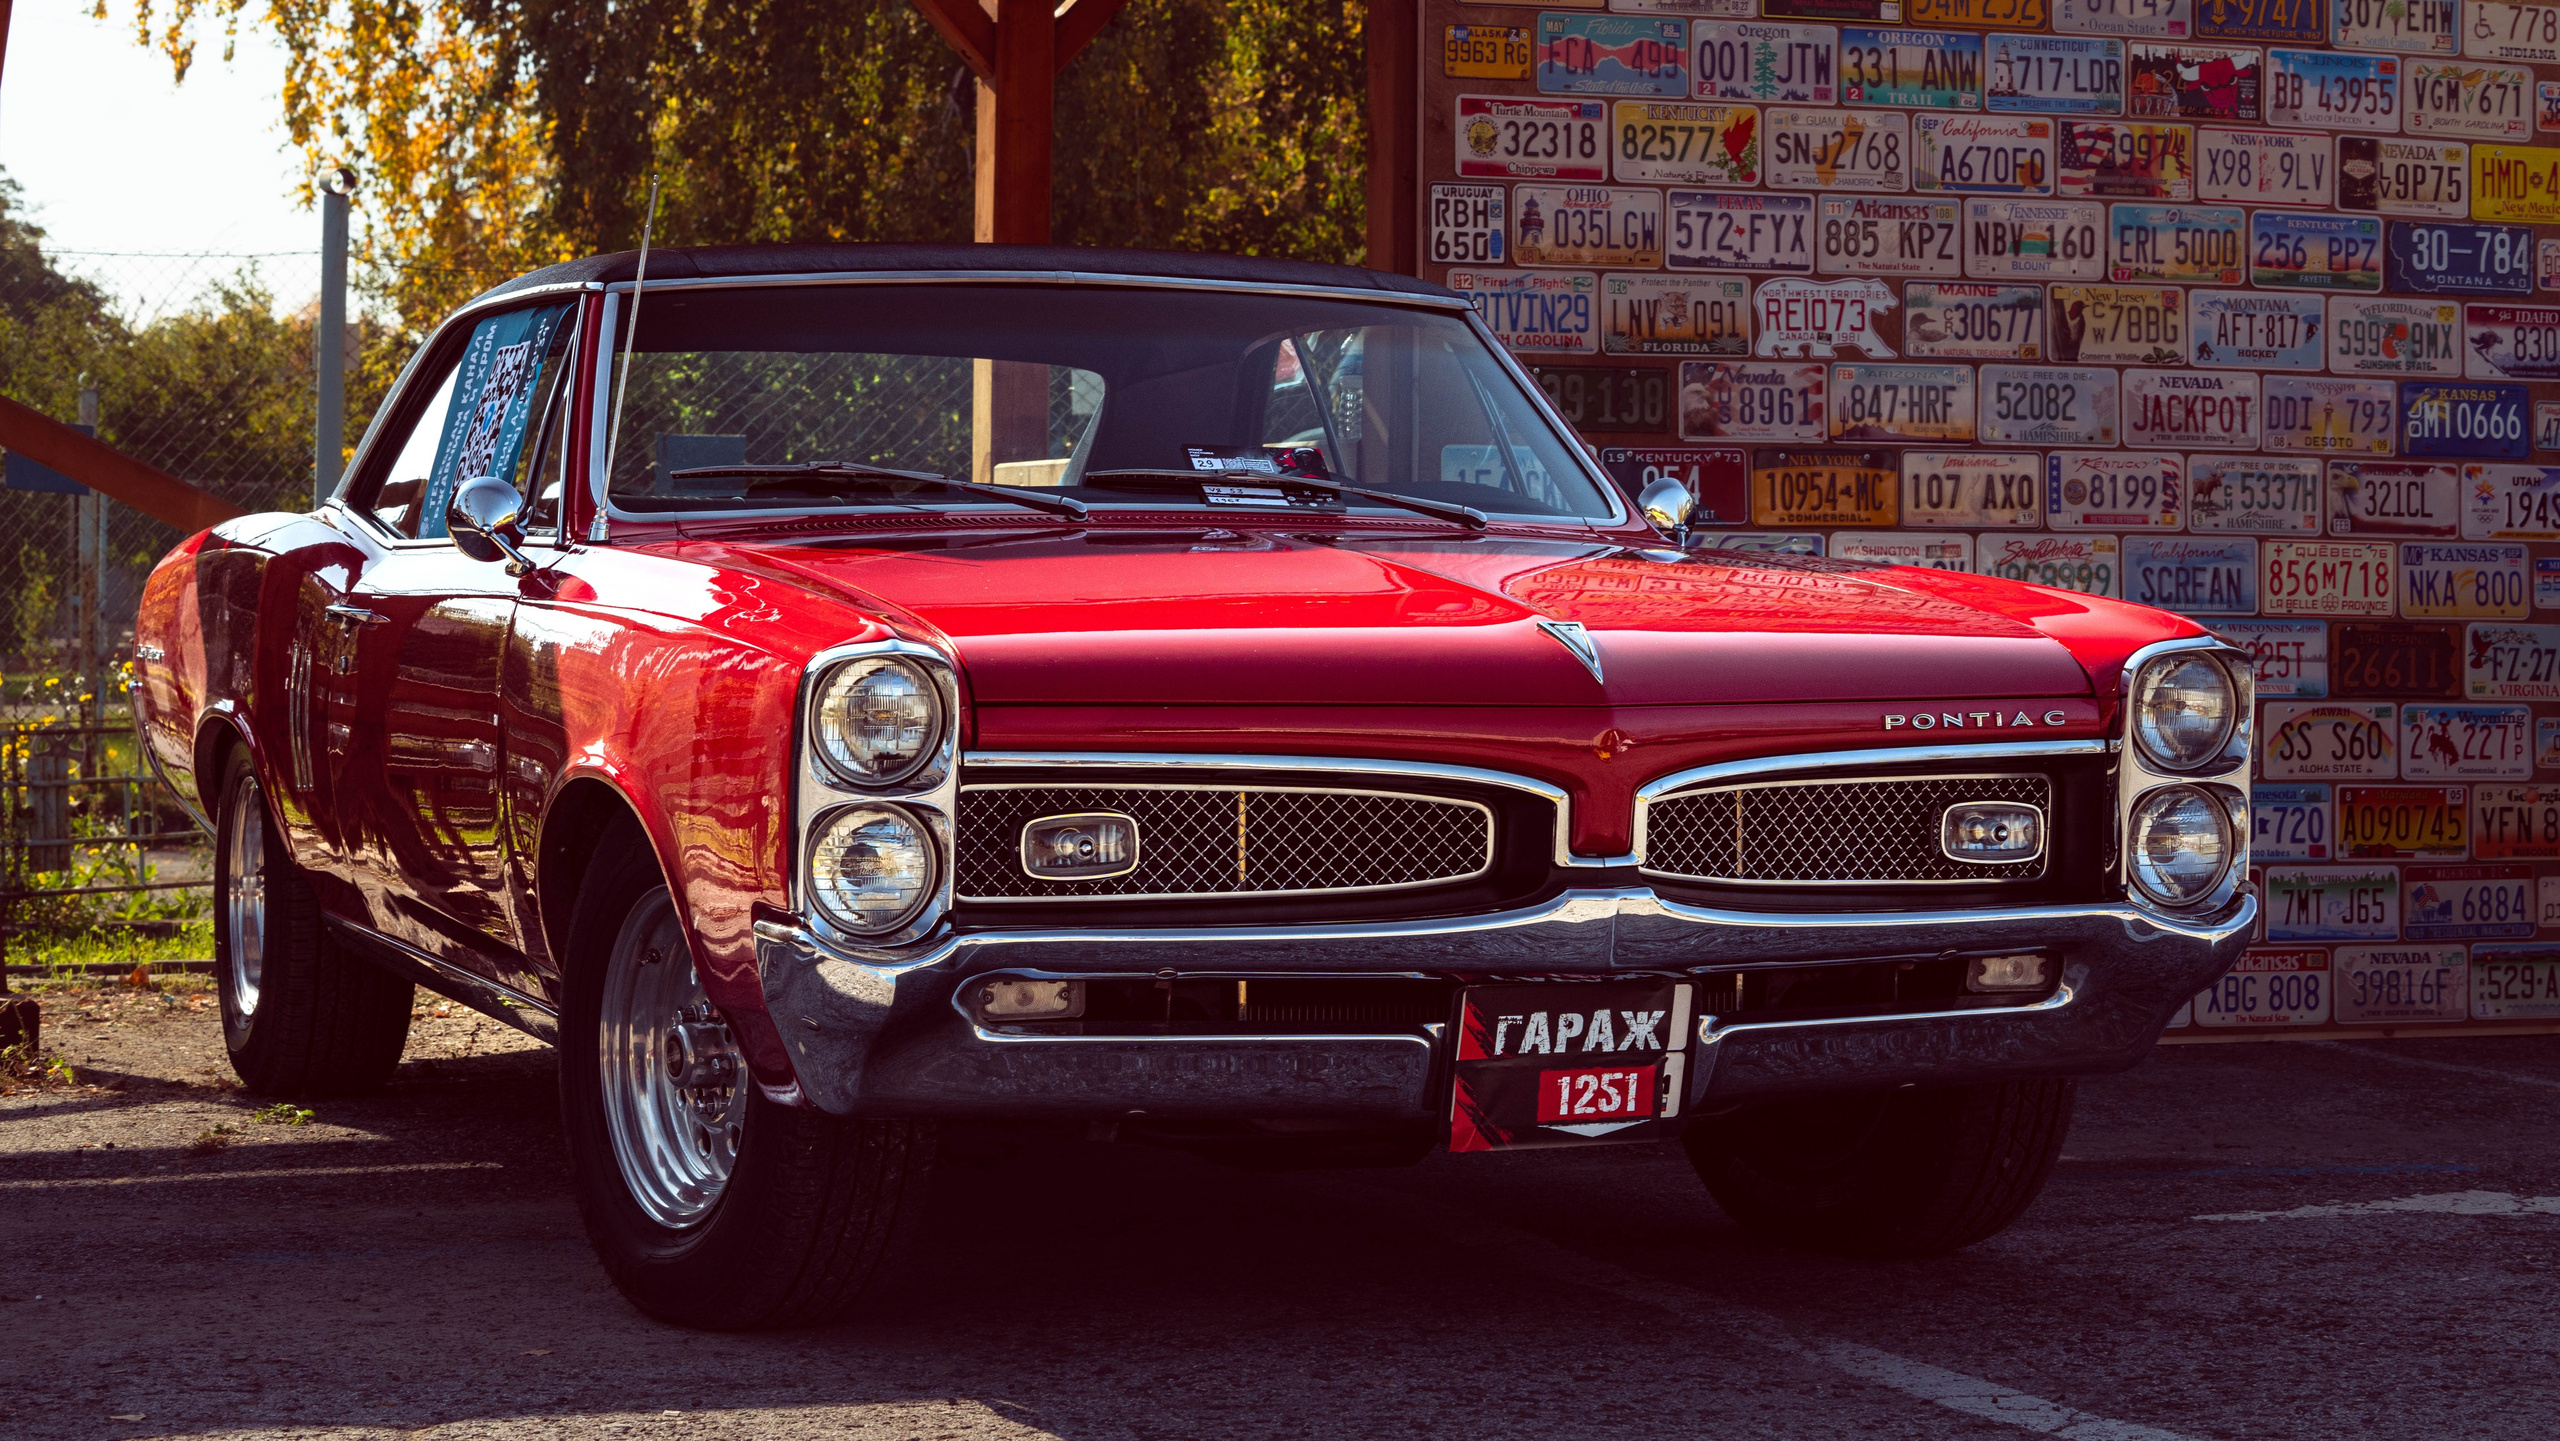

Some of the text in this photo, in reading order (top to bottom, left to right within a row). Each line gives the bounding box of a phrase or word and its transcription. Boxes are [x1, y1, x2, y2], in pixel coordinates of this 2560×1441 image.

[1546, 20, 1564, 33] MAY
[1584, 17, 1633, 36] Florida
[1737, 24, 1790, 42] Oregon
[2089, 18, 2156, 34] Ocean State
[1469, 29, 1508, 38] ALASKA
[1878, 31, 1945, 46] OREGON
[2020, 39, 2091, 52] CONNECTICUT
[2364, 35, 2426, 50] South Carolina
[1448, 42, 1528, 64] 9963 RG
[1548, 37, 1678, 78] FCA 499
[2499, 46, 2557, 60] INDIANA
[1699, 40, 1830, 85] 001 JTW
[1848, 46, 1976, 91] 331 ANW
[1887, 92, 1936, 106] TRAIL
[2274, 72, 2303, 110] BB
[2318, 75, 2393, 115] 43955
[2414, 78, 2520, 117] VGM 671
[1494, 104, 1569, 119] Turtle Mountain
[1648, 104, 1728, 122] KENTUCKY
[1806, 115, 1836, 127] GUAM
[1922, 119, 1939, 130] SEP
[2465, 121, 2505, 130] CAROLINA
[1942, 118, 2023, 139] California
[1504, 121, 1596, 159] 32318
[1622, 124, 1715, 162] 82577
[2231, 133, 2295, 148] NEW YORK
[1776, 131, 1900, 171] SNJ2768
[2377, 143, 2437, 161] NEVADA
[1508, 161, 1555, 176] Chippewa
[1696, 170, 1723, 181] Finest
[2207, 148, 2324, 190] X98 9LV
[1834, 178, 1874, 186] CHAMORRO
[1442, 187, 1493, 198] URUGUAY
[1566, 188, 1610, 203] OHIO
[1715, 195, 1763, 211] TEXAS
[1851, 199, 1930, 220] Arkansas
[2502, 201, 2524, 213] New
[1435, 199, 1488, 228] RBH
[1973, 205, 1988, 216] MAR
[1676, 210, 1805, 253] 572 FYX
[2287, 219, 2346, 231] KENTUCKY
[1825, 219, 1954, 260] 885 KPZ
[1974, 220, 2025, 258] NBV
[2120, 225, 2236, 267] ERL 5000
[2257, 232, 2377, 272] 256 PPZ
[2012, 261, 2051, 271] BLOUNT
[2115, 269, 2131, 280] 17
[2299, 275, 2332, 284] FAYETTE
[2426, 275, 2493, 286] MONTANA
[1483, 277, 1564, 289] First Flight
[1608, 281, 1626, 294] DEC
[1641, 278, 1711, 288] Protect the Panther
[1762, 289, 1888, 299] NORTHWEST TERRITORIES
[1937, 284, 1998, 297] MAINE
[2085, 288, 2146, 304] New Jersey
[2226, 298, 2290, 312] MONTANA
[1953, 303, 2035, 344] 30677
[2515, 311, 2559, 324] IDAHO
[1516, 334, 1583, 348] CAROLINA
[1779, 332, 1860, 342] CANADA 1981
[1643, 341, 1710, 353] FLORIDA
[1943, 349, 2010, 358] NATURAL TREASURE
[2238, 350, 2278, 358] HOCKEY
[2080, 352, 2140, 361] Conserve Wildlife
[2360, 360, 2432, 371] SUNSHINE STATE
[1722, 365, 1786, 386] Nevada
[1836, 369, 1854, 380] FEB
[1867, 370, 1938, 380] ARIZONA
[2012, 371, 2069, 380] LIVE FREE OR
[2159, 377, 2224, 390] NEVADA
[2439, 388, 2496, 401] KANSAS
[1996, 383, 2077, 422] 52082
[2133, 394, 2250, 433] JACKPOT
[2346, 399, 2392, 434] 793
[429, 335, 484, 509] TELEGRAM КАНАЛ
[2019, 430, 2081, 442] HAMPSHIRE
[2305, 437, 2353, 448] DESOTO
[1198, 459, 1213, 468] 29
[1607, 452, 1742, 464] 19 KENTUCKY 73
[1789, 454, 1863, 467] NEW YORK
[1942, 455, 2002, 469] Louisiana
[2220, 461, 2260, 470] LIVE FREE
[2513, 476, 2541, 487] UTAH
[1912, 474, 1961, 509] 107
[2365, 480, 2433, 518] 321CL
[1788, 514, 1864, 523] COMMERCIAL
[2227, 518, 2285, 530] HAMPSHIRE
[1843, 545, 1919, 556] WASHINGTON
[2372, 549, 2387, 558] 76
[2431, 548, 2499, 562] KANSAS
[2506, 549, 2520, 557] SEP
[2269, 559, 2389, 598] 856M718
[2409, 570, 2521, 606] NKA 800
[2270, 599, 2388, 611] LA BELLE PROVINCE
[2229, 624, 2293, 633] WISCONSIN
[2500, 684, 2559, 697] VIRGINIA
[2312, 708, 2350, 717] HAWAII
[2458, 710, 2525, 727] Wyoming
[1884, 710, 2066, 730] PONTIAC
[2279, 721, 2312, 761] SS
[2299, 764, 2362, 774] ALOHA STATE
[2377, 790, 2429, 800] Maryland
[2272, 807, 2324, 843] 720
[2310, 875, 2358, 883] MICHIGAN
[2462, 885, 2525, 922] 6884
[2369, 953, 2432, 965] NEVADA
[2269, 974, 2320, 1011] 808
[2250, 1014, 2275, 1022] Natural
[1494, 1008, 1666, 1056] ГАРАЖ
[1557, 1072, 1638, 1116] 1251
